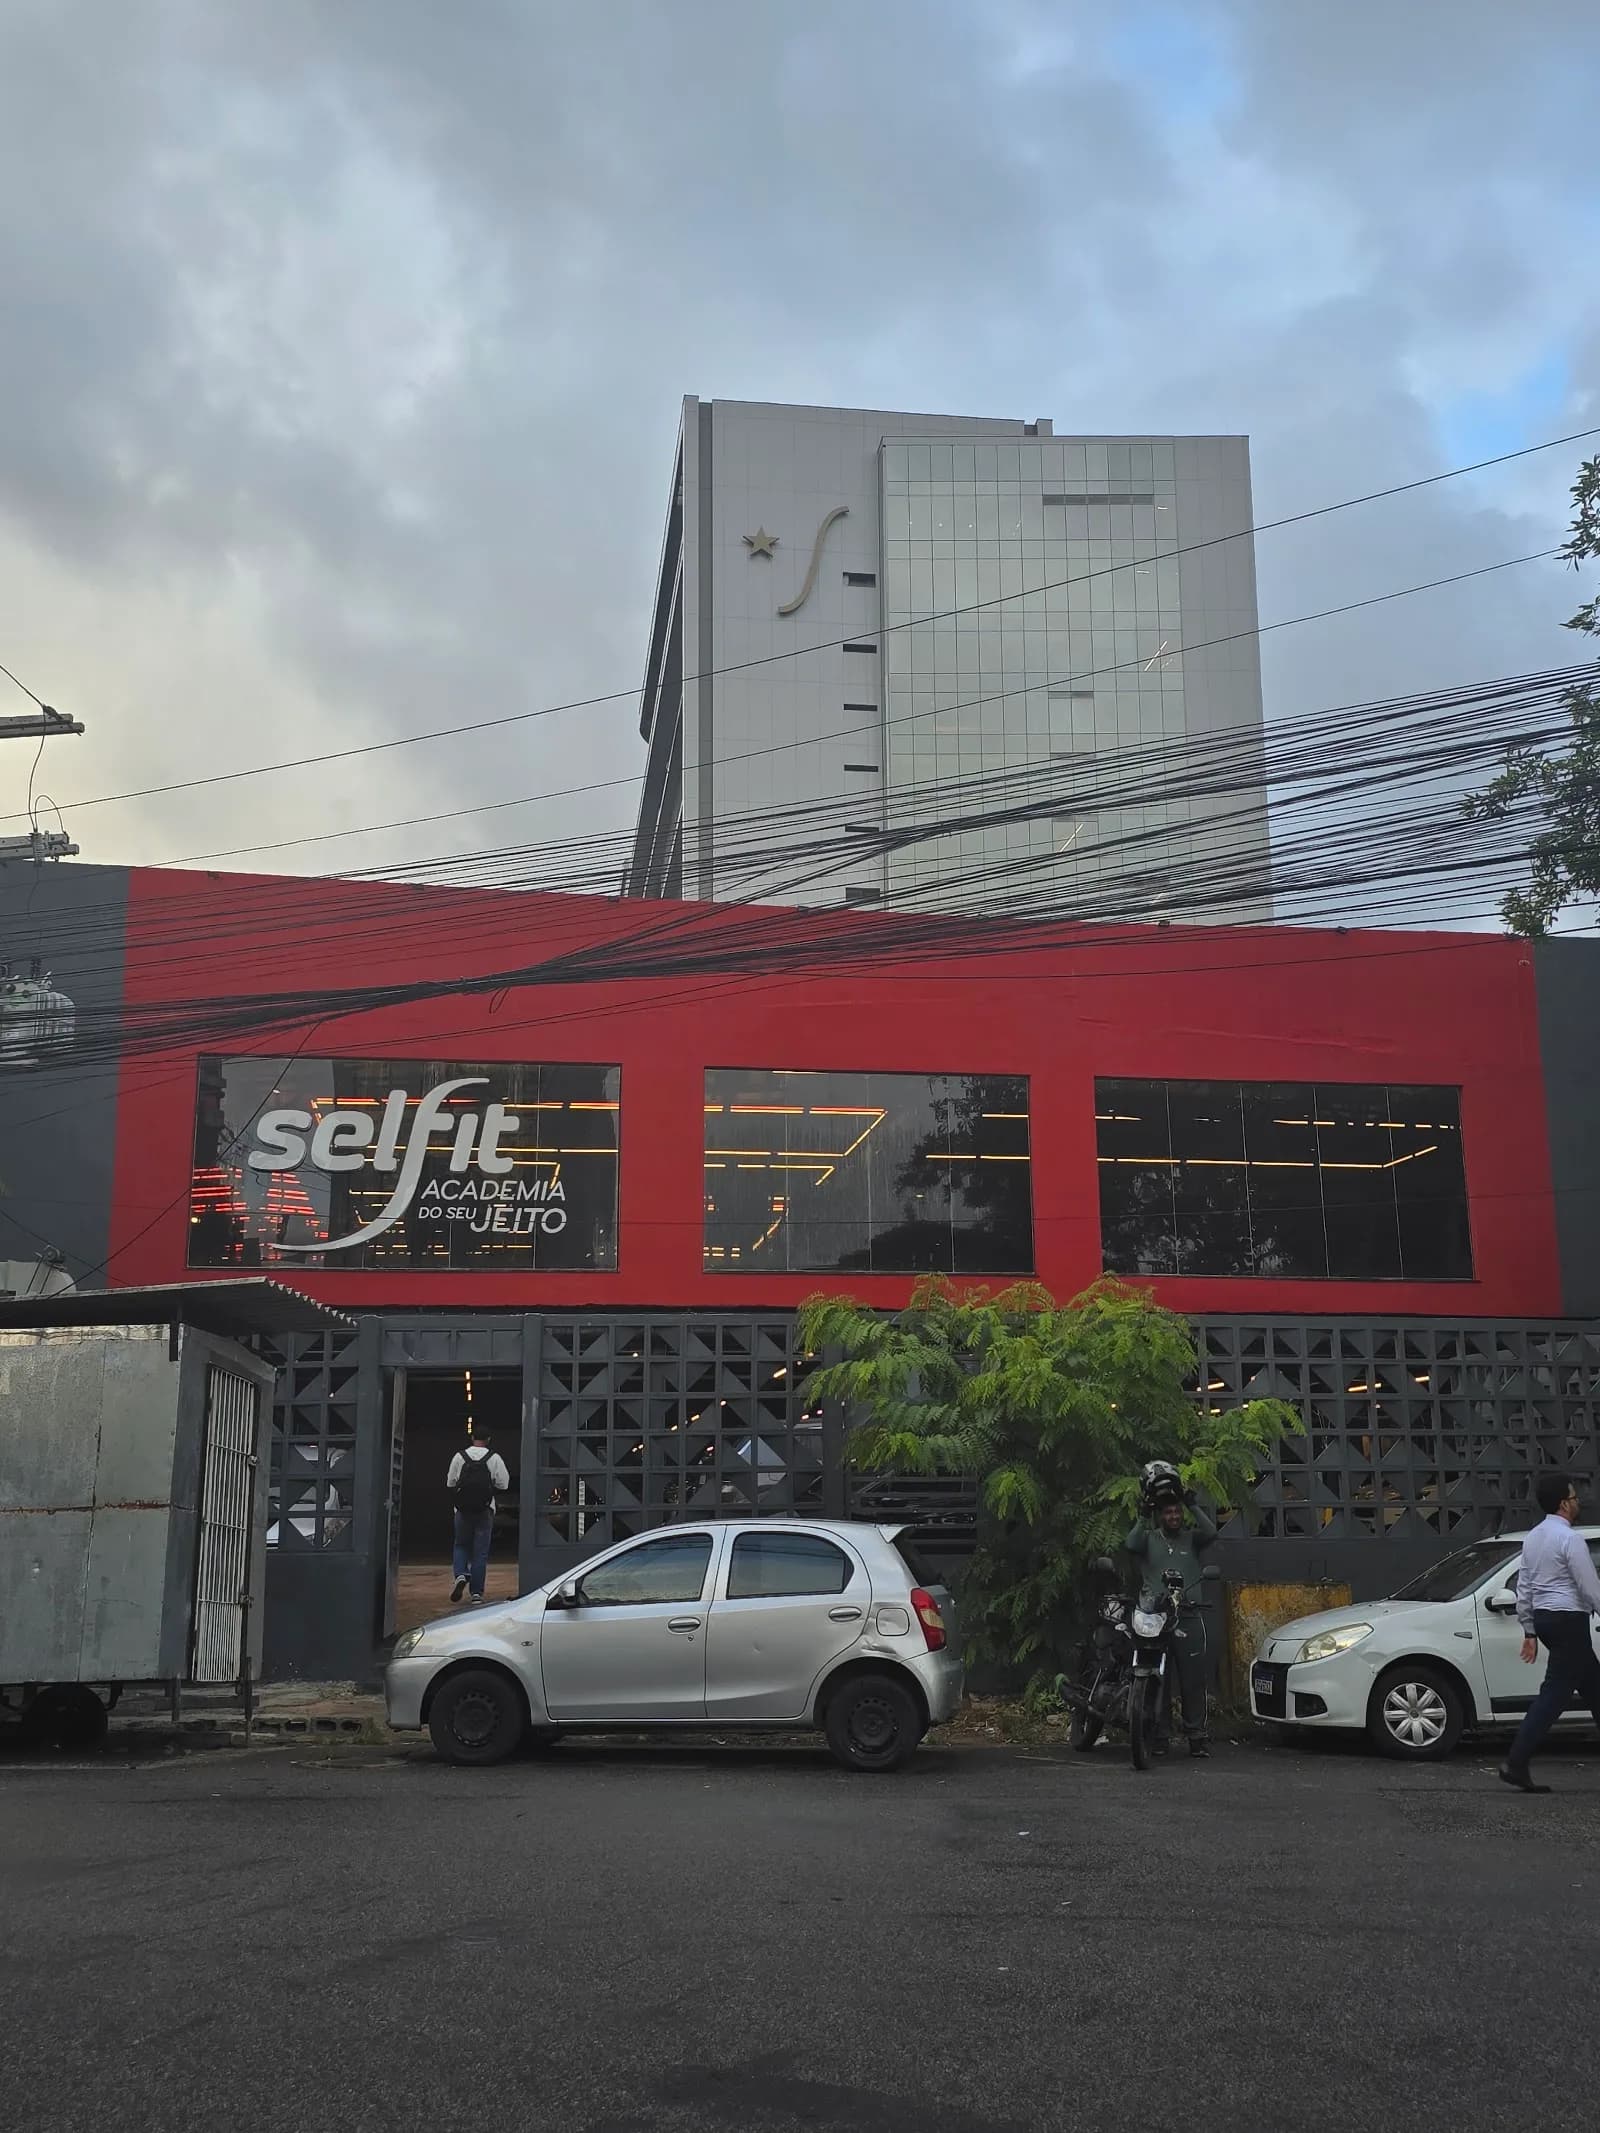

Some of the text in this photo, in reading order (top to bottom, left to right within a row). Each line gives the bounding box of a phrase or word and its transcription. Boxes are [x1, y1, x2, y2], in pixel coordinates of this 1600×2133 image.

[247, 1077, 520, 1252] selfit
[421, 1179, 566, 1201] ACADEMIA
[418, 1206, 567, 1234] DO SEU JEITO
